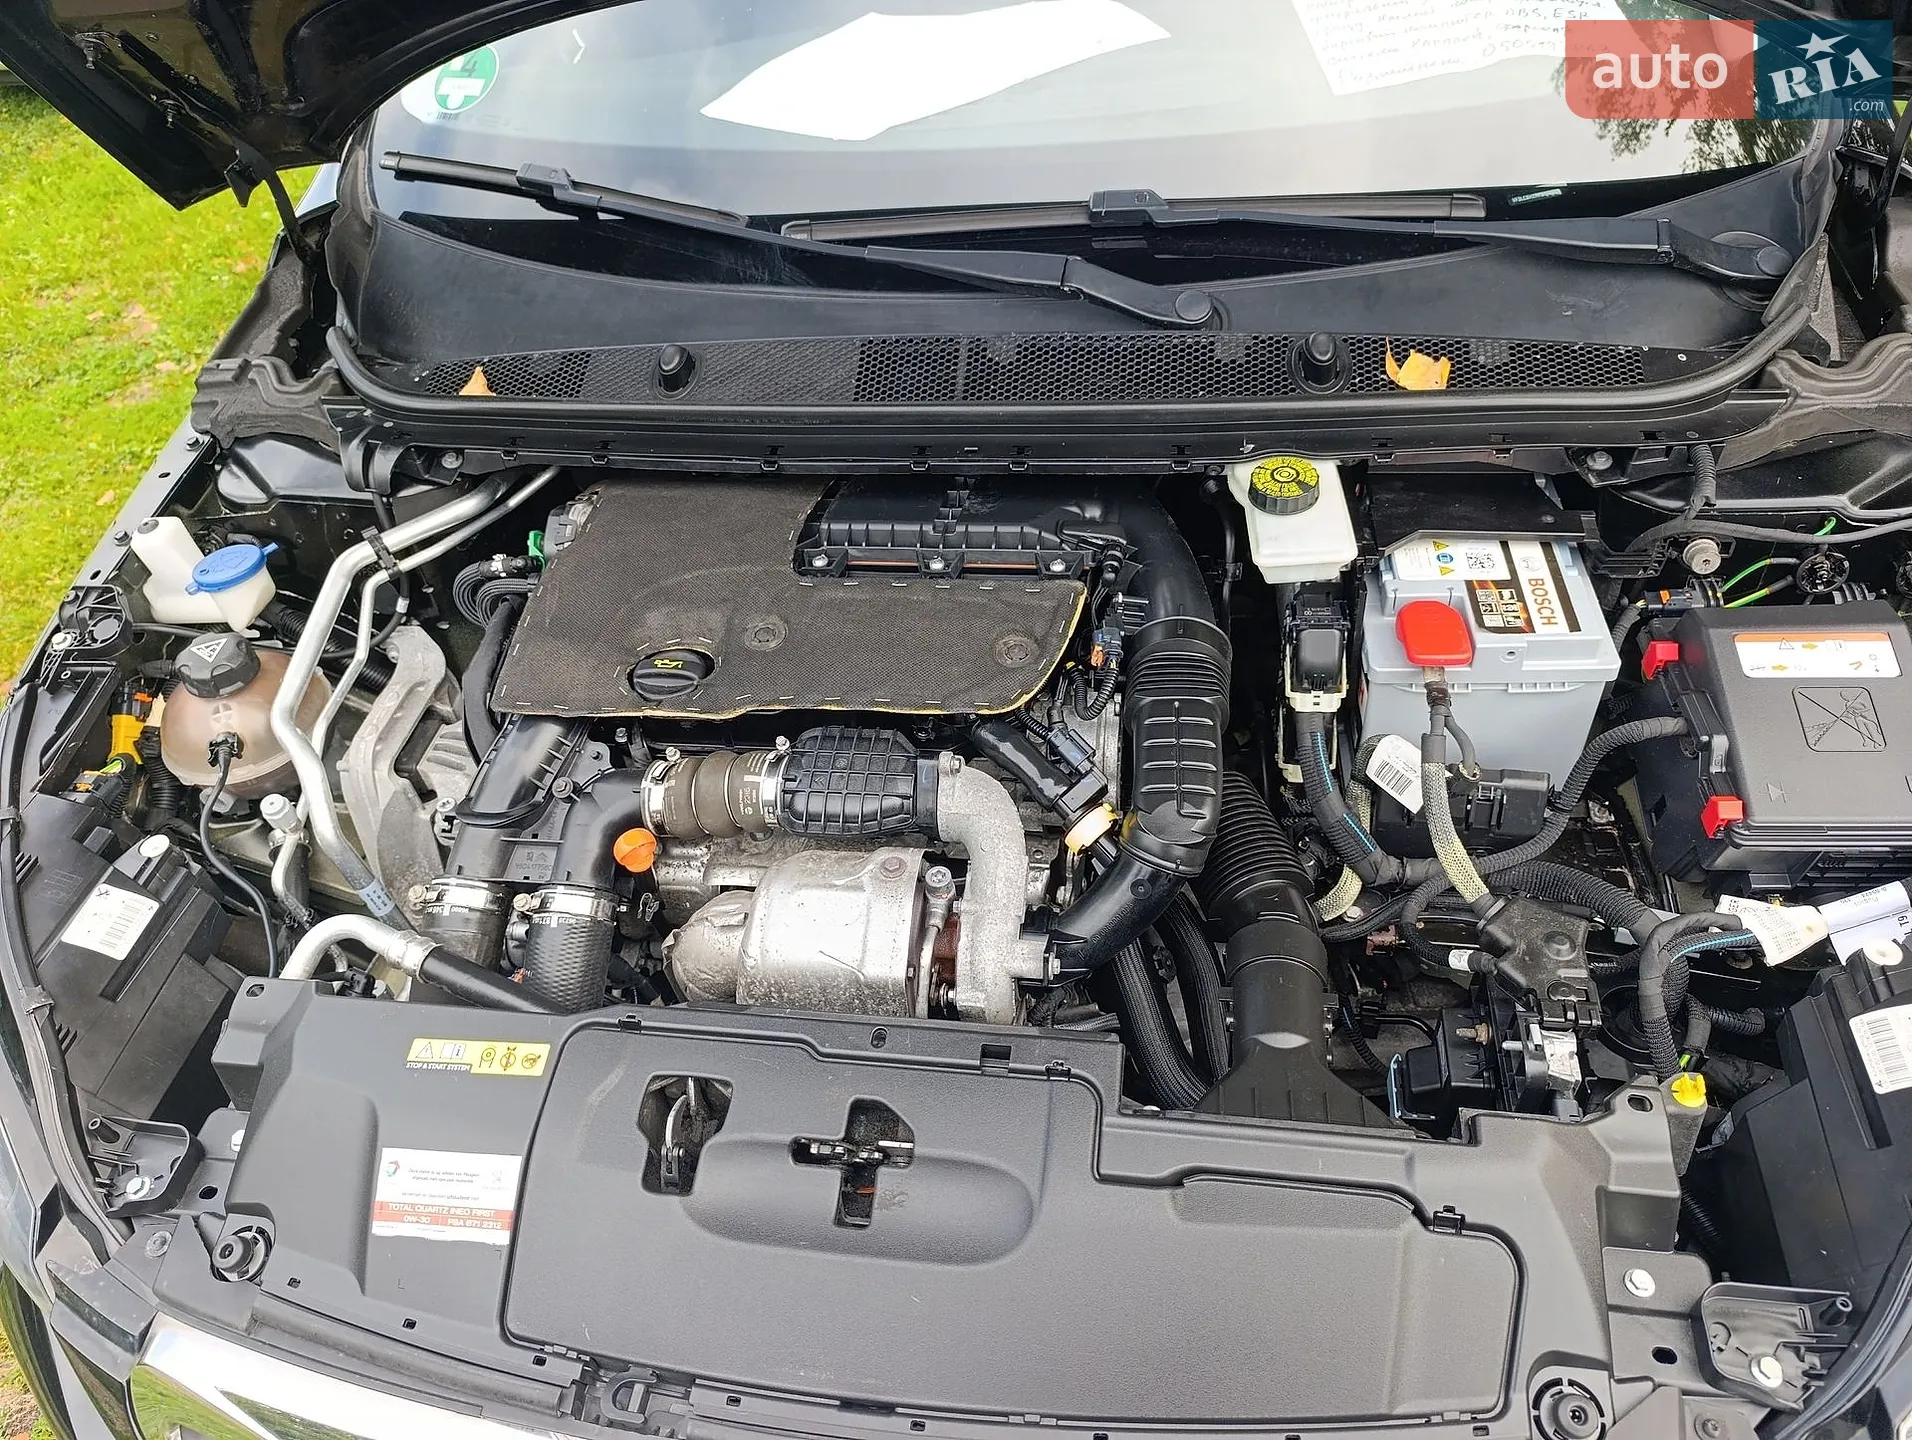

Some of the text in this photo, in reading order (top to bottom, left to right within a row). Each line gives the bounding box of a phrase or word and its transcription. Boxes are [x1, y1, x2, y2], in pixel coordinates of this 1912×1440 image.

[1527, 578, 1559, 626] BOSCH
[388, 1203, 496, 1217] TOTAL QUARTZ INEO FIRST
[403, 1215, 431, 1224] 0W-30
[447, 1218, 464, 1227] PSA
[481, 1220, 503, 1229] 2312
